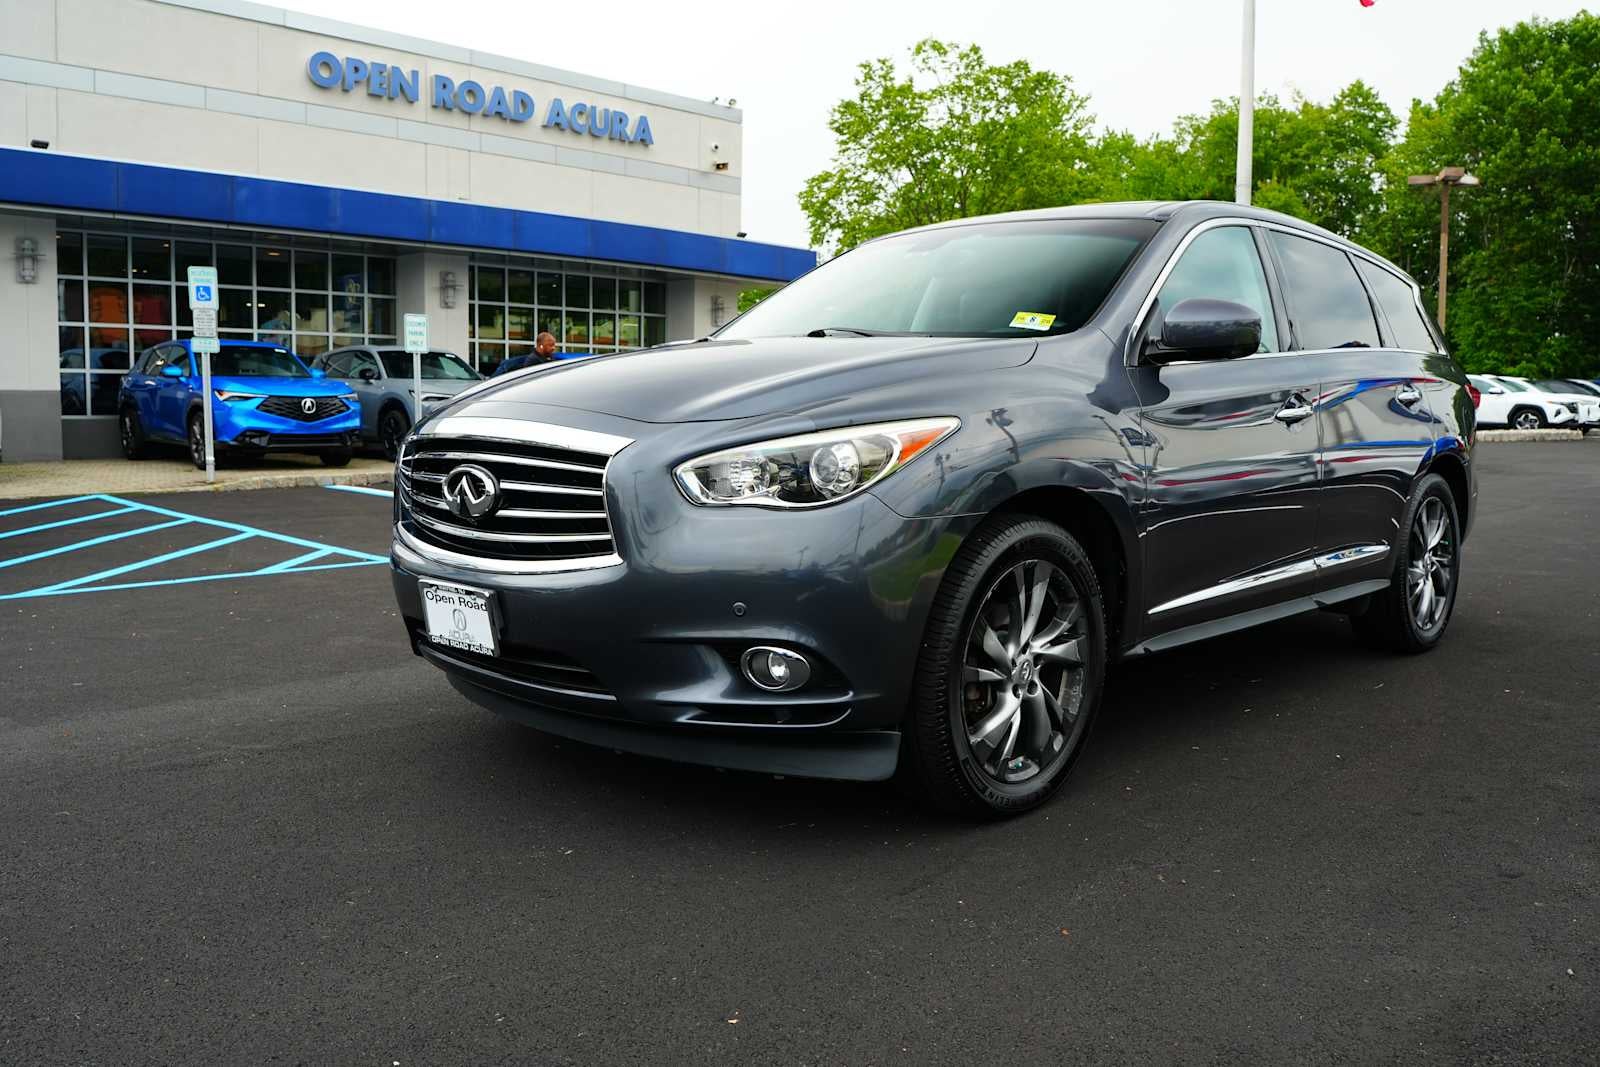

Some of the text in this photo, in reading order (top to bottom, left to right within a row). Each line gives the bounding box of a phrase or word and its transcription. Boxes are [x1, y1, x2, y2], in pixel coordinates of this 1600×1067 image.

[306, 51, 655, 146] OPEN ROAD ACURA
[425, 590, 455, 604] Open
[458, 596, 488, 612] Road
[431, 635, 493, 656] OPEN ROAD ACURA
